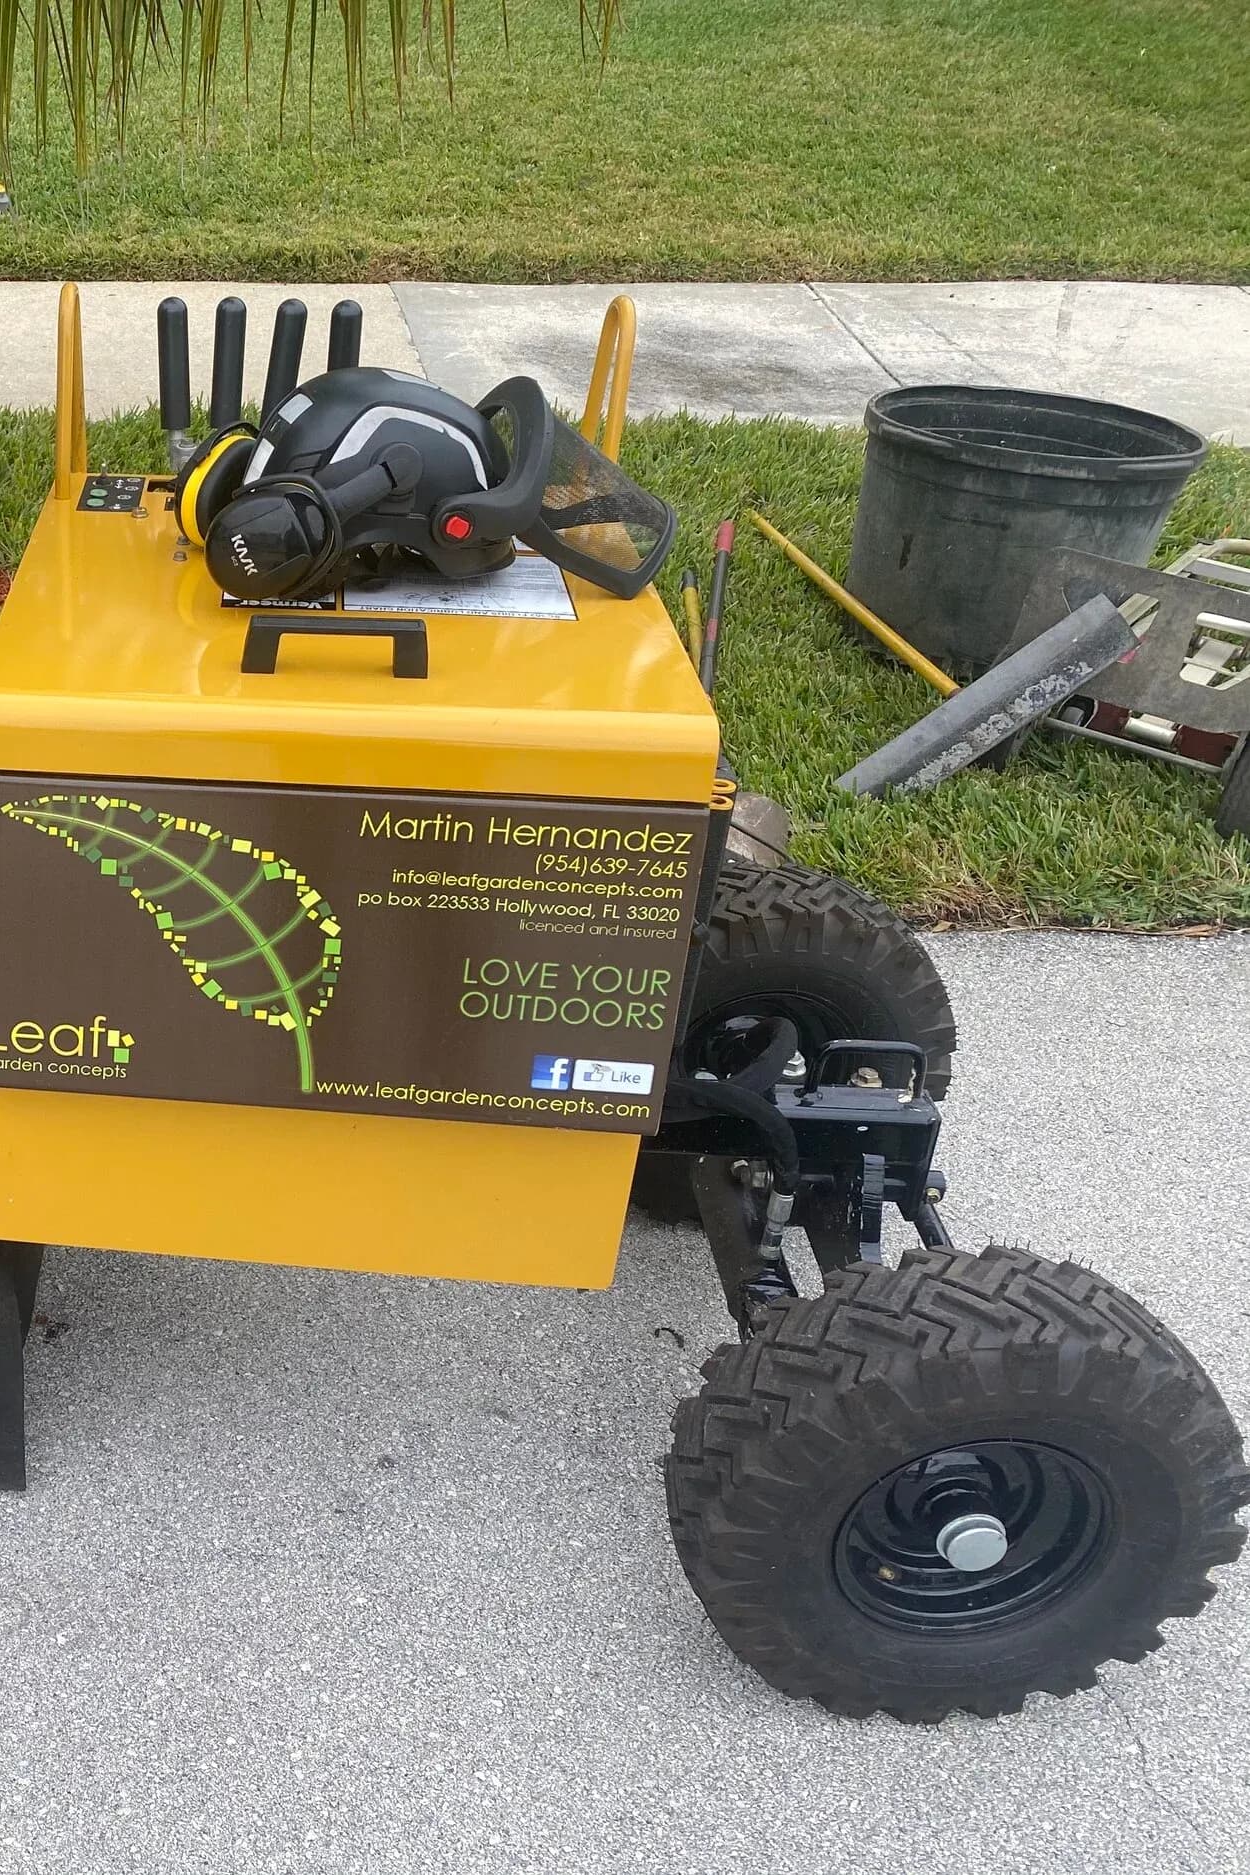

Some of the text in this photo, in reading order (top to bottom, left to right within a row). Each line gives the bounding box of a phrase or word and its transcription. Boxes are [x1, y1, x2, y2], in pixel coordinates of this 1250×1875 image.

[231, 534, 258, 576] KASK
[240, 599, 322, 609] Vermeer
[359, 809, 694, 855] Martin Hernandez
[535, 853, 688, 879] (954)639-7645
[392, 869, 683, 900] info@leafgardenconcepts.com
[358, 891, 680, 922] po box 223533 Hollywood, FL 33020
[519, 919, 678, 940] licenced and insured
[463, 957, 671, 996] LOVE YOUR
[460, 991, 666, 1030] OUTDOORS
[47, 1060, 127, 1080] concepts
[611, 1070, 642, 1084] Like
[316, 1080, 651, 1118] www.leafgardenconcepts.com
